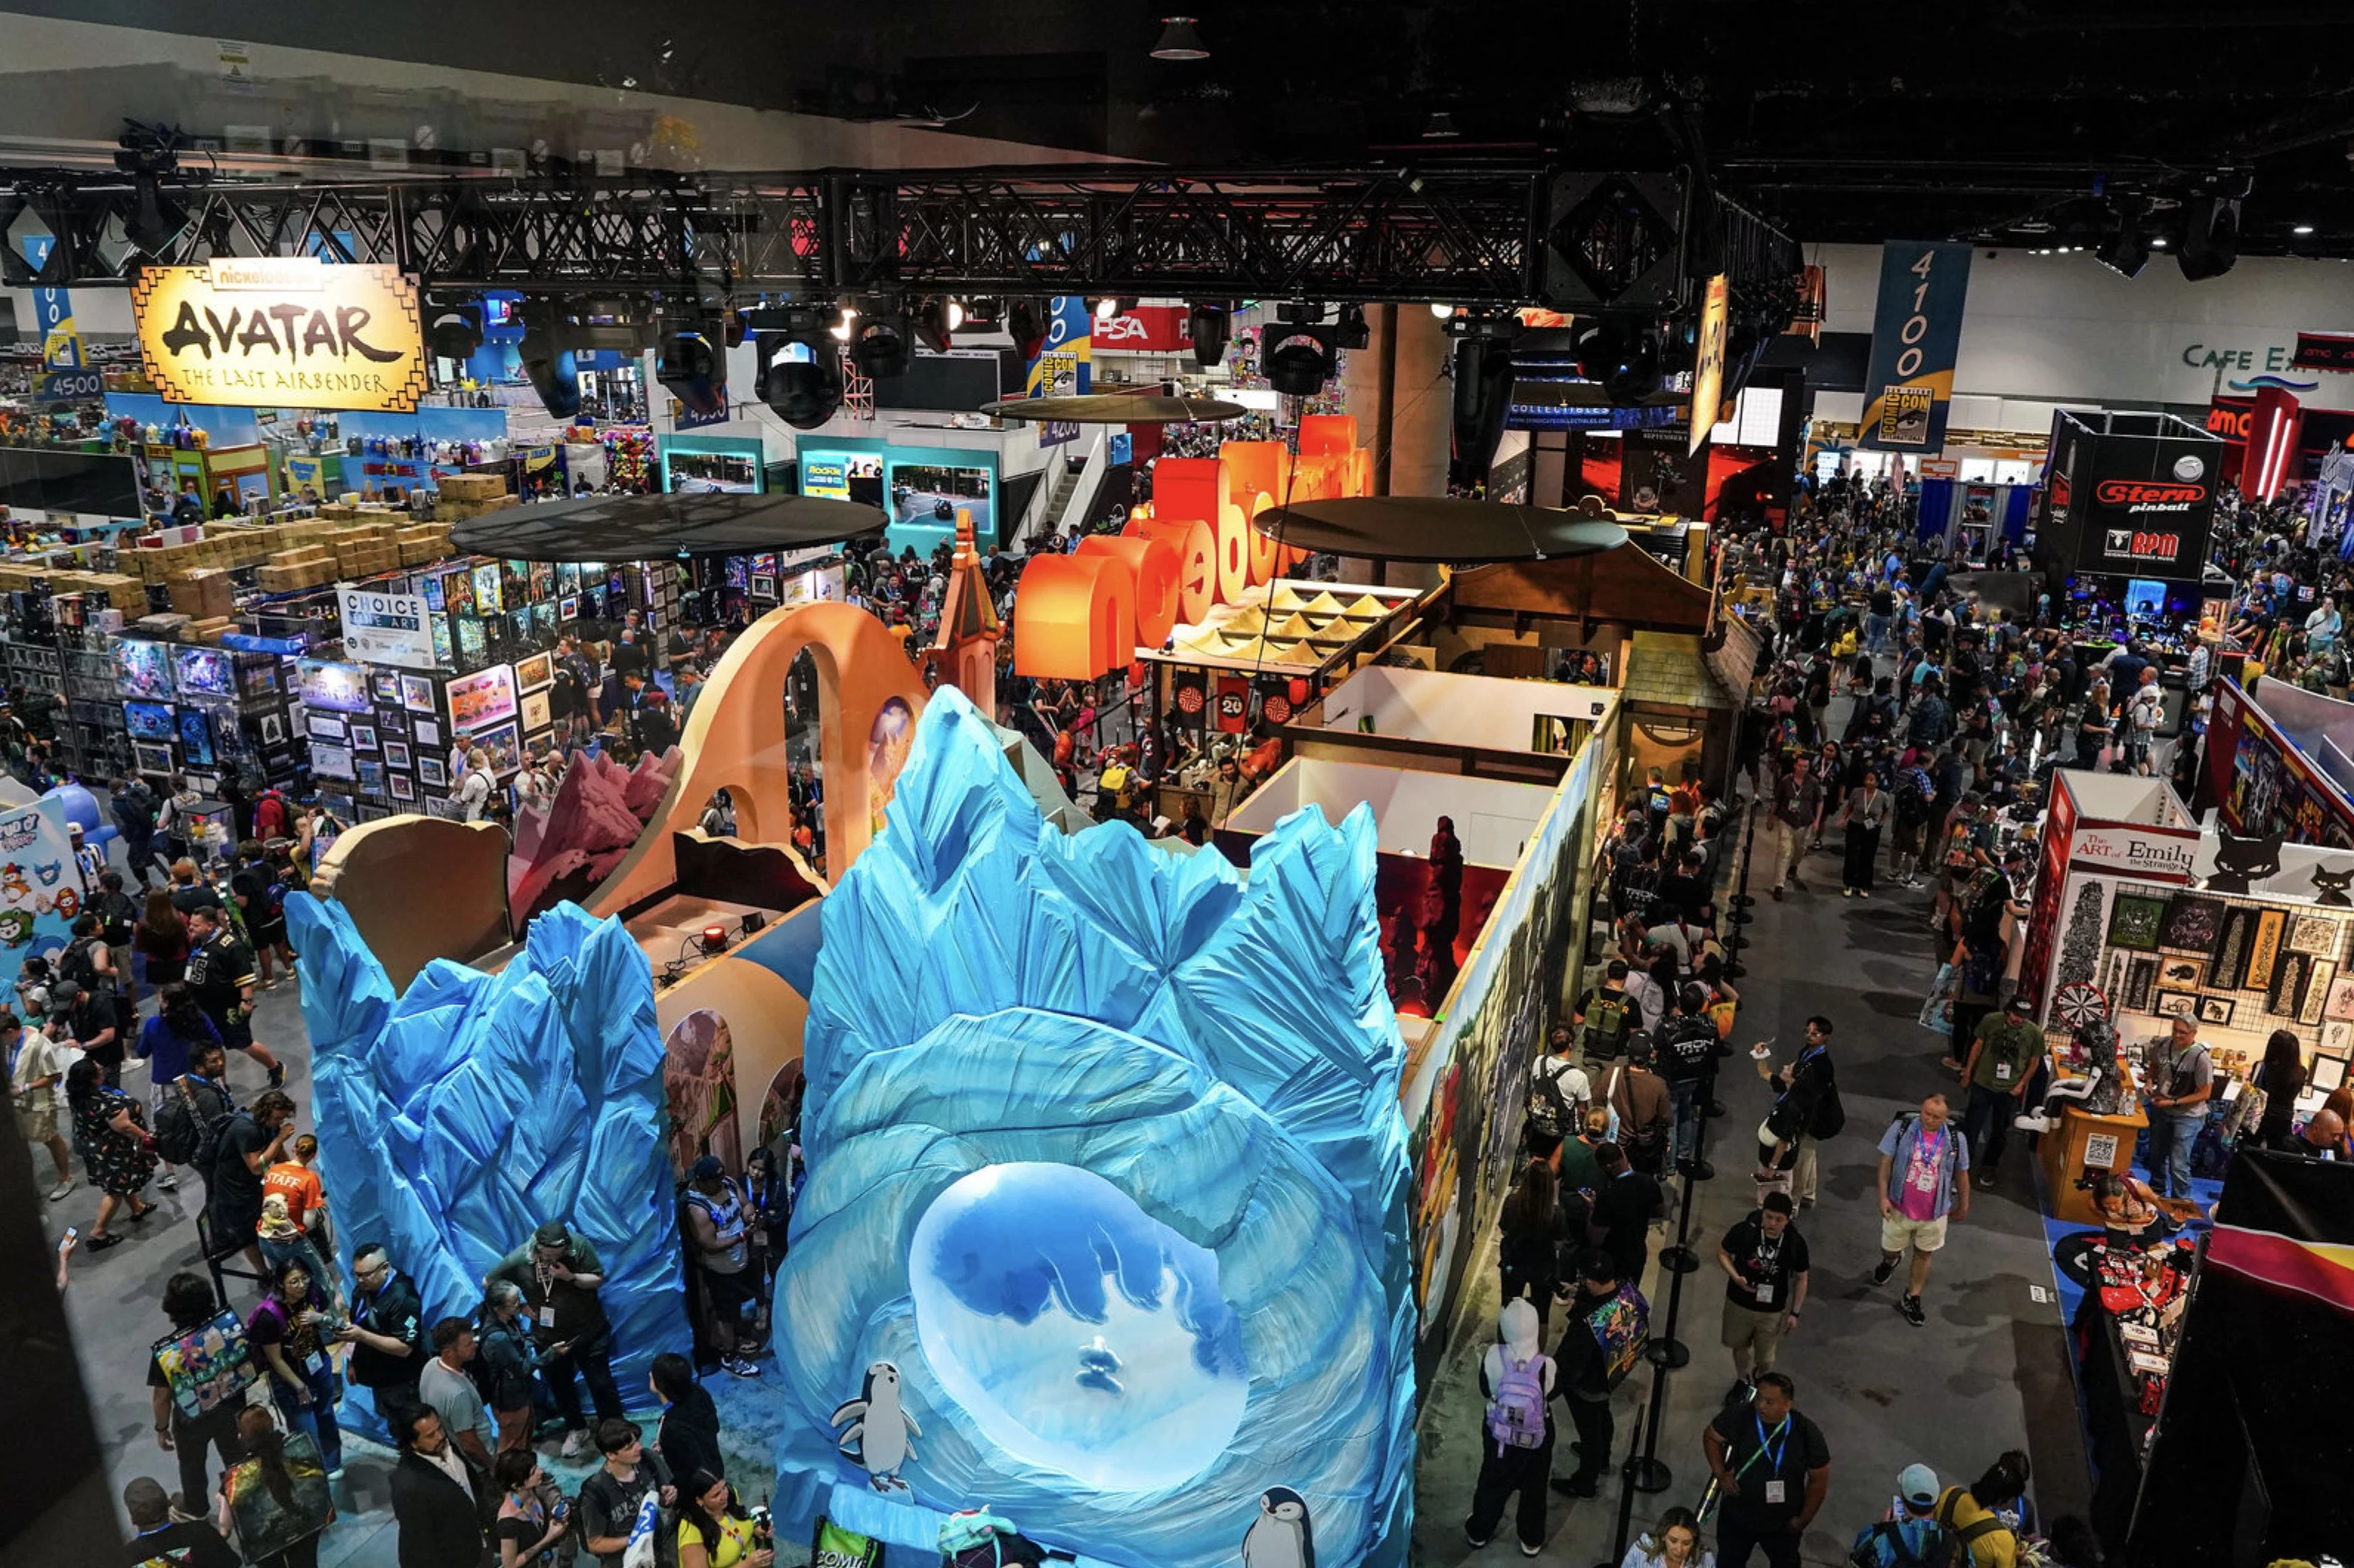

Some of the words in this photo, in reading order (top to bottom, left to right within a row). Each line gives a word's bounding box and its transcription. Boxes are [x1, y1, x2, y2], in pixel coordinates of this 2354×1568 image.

[1896, 250, 1935, 376] 4100
[162, 300, 404, 365] AVATAR
[1093, 316, 1149, 340] PSA
[1054, 358, 1075, 371] CON
[2183, 344, 2253, 370] CAFE
[182, 369, 214, 387] THE
[224, 369, 267, 389] LAST
[276, 370, 390, 393] AIRBENDER
[1044, 357, 1054, 392] COMIC
[52, 375, 100, 396] 4500
[1900, 394, 1930, 410] CON
[1882, 394, 1901, 434] COMIC
[2106, 485, 2200, 503] Stern
[2129, 502, 2191, 514] pinball
[2132, 531, 2180, 556] RPM
[347, 595, 419, 616] CHOICE
[2087, 833, 2108, 844] The
[2076, 842, 2113, 856] ART
[2111, 851, 2123, 859] of
[2126, 840, 2194, 870] Emily
[2143, 860, 2180, 872] Strange
[1674, 1038, 1715, 1053] TRON
[265, 1173, 301, 1188] STAFF
[816, 1550, 863, 1568] COMI
